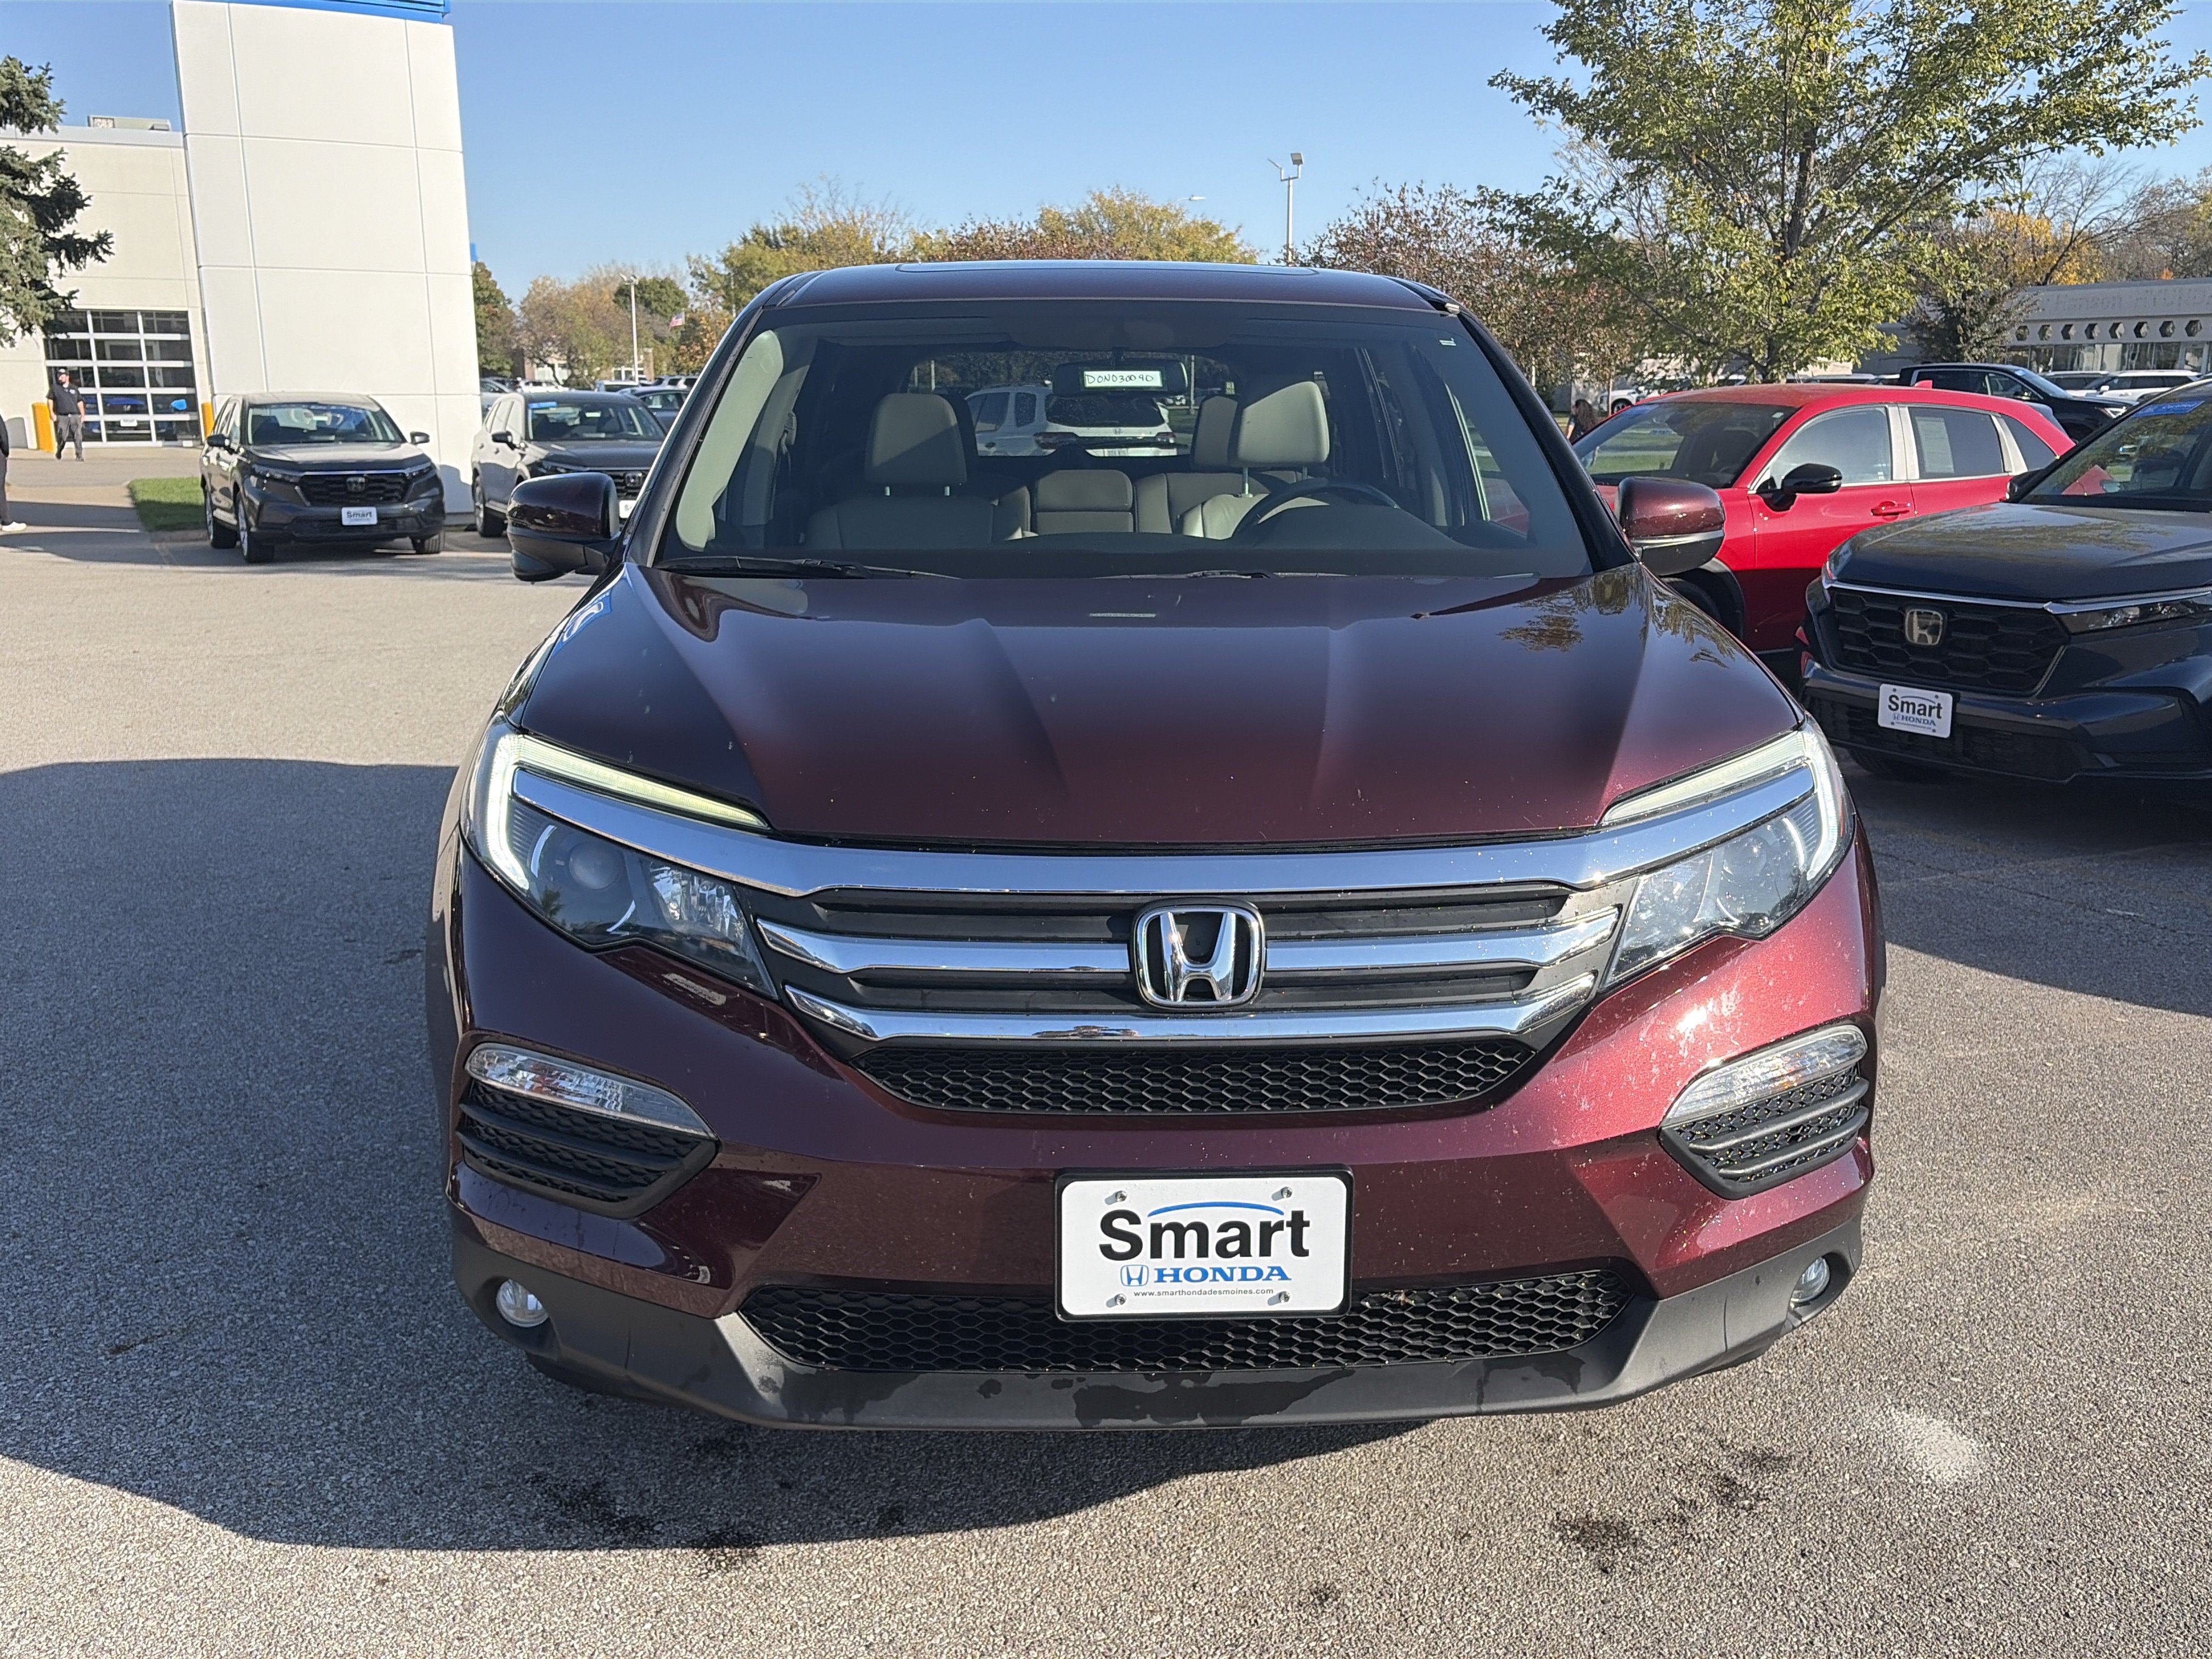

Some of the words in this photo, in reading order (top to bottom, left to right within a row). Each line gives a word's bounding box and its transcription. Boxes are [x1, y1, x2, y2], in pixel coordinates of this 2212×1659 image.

[1888, 695, 1943, 719] Smart
[1901, 716, 1936, 726] HONDA
[1099, 1209, 1310, 1261] Smart
[1154, 1266, 1291, 1283] HONDA
[1133, 1288, 1273, 1297] www.smarthondadesmoines.com
